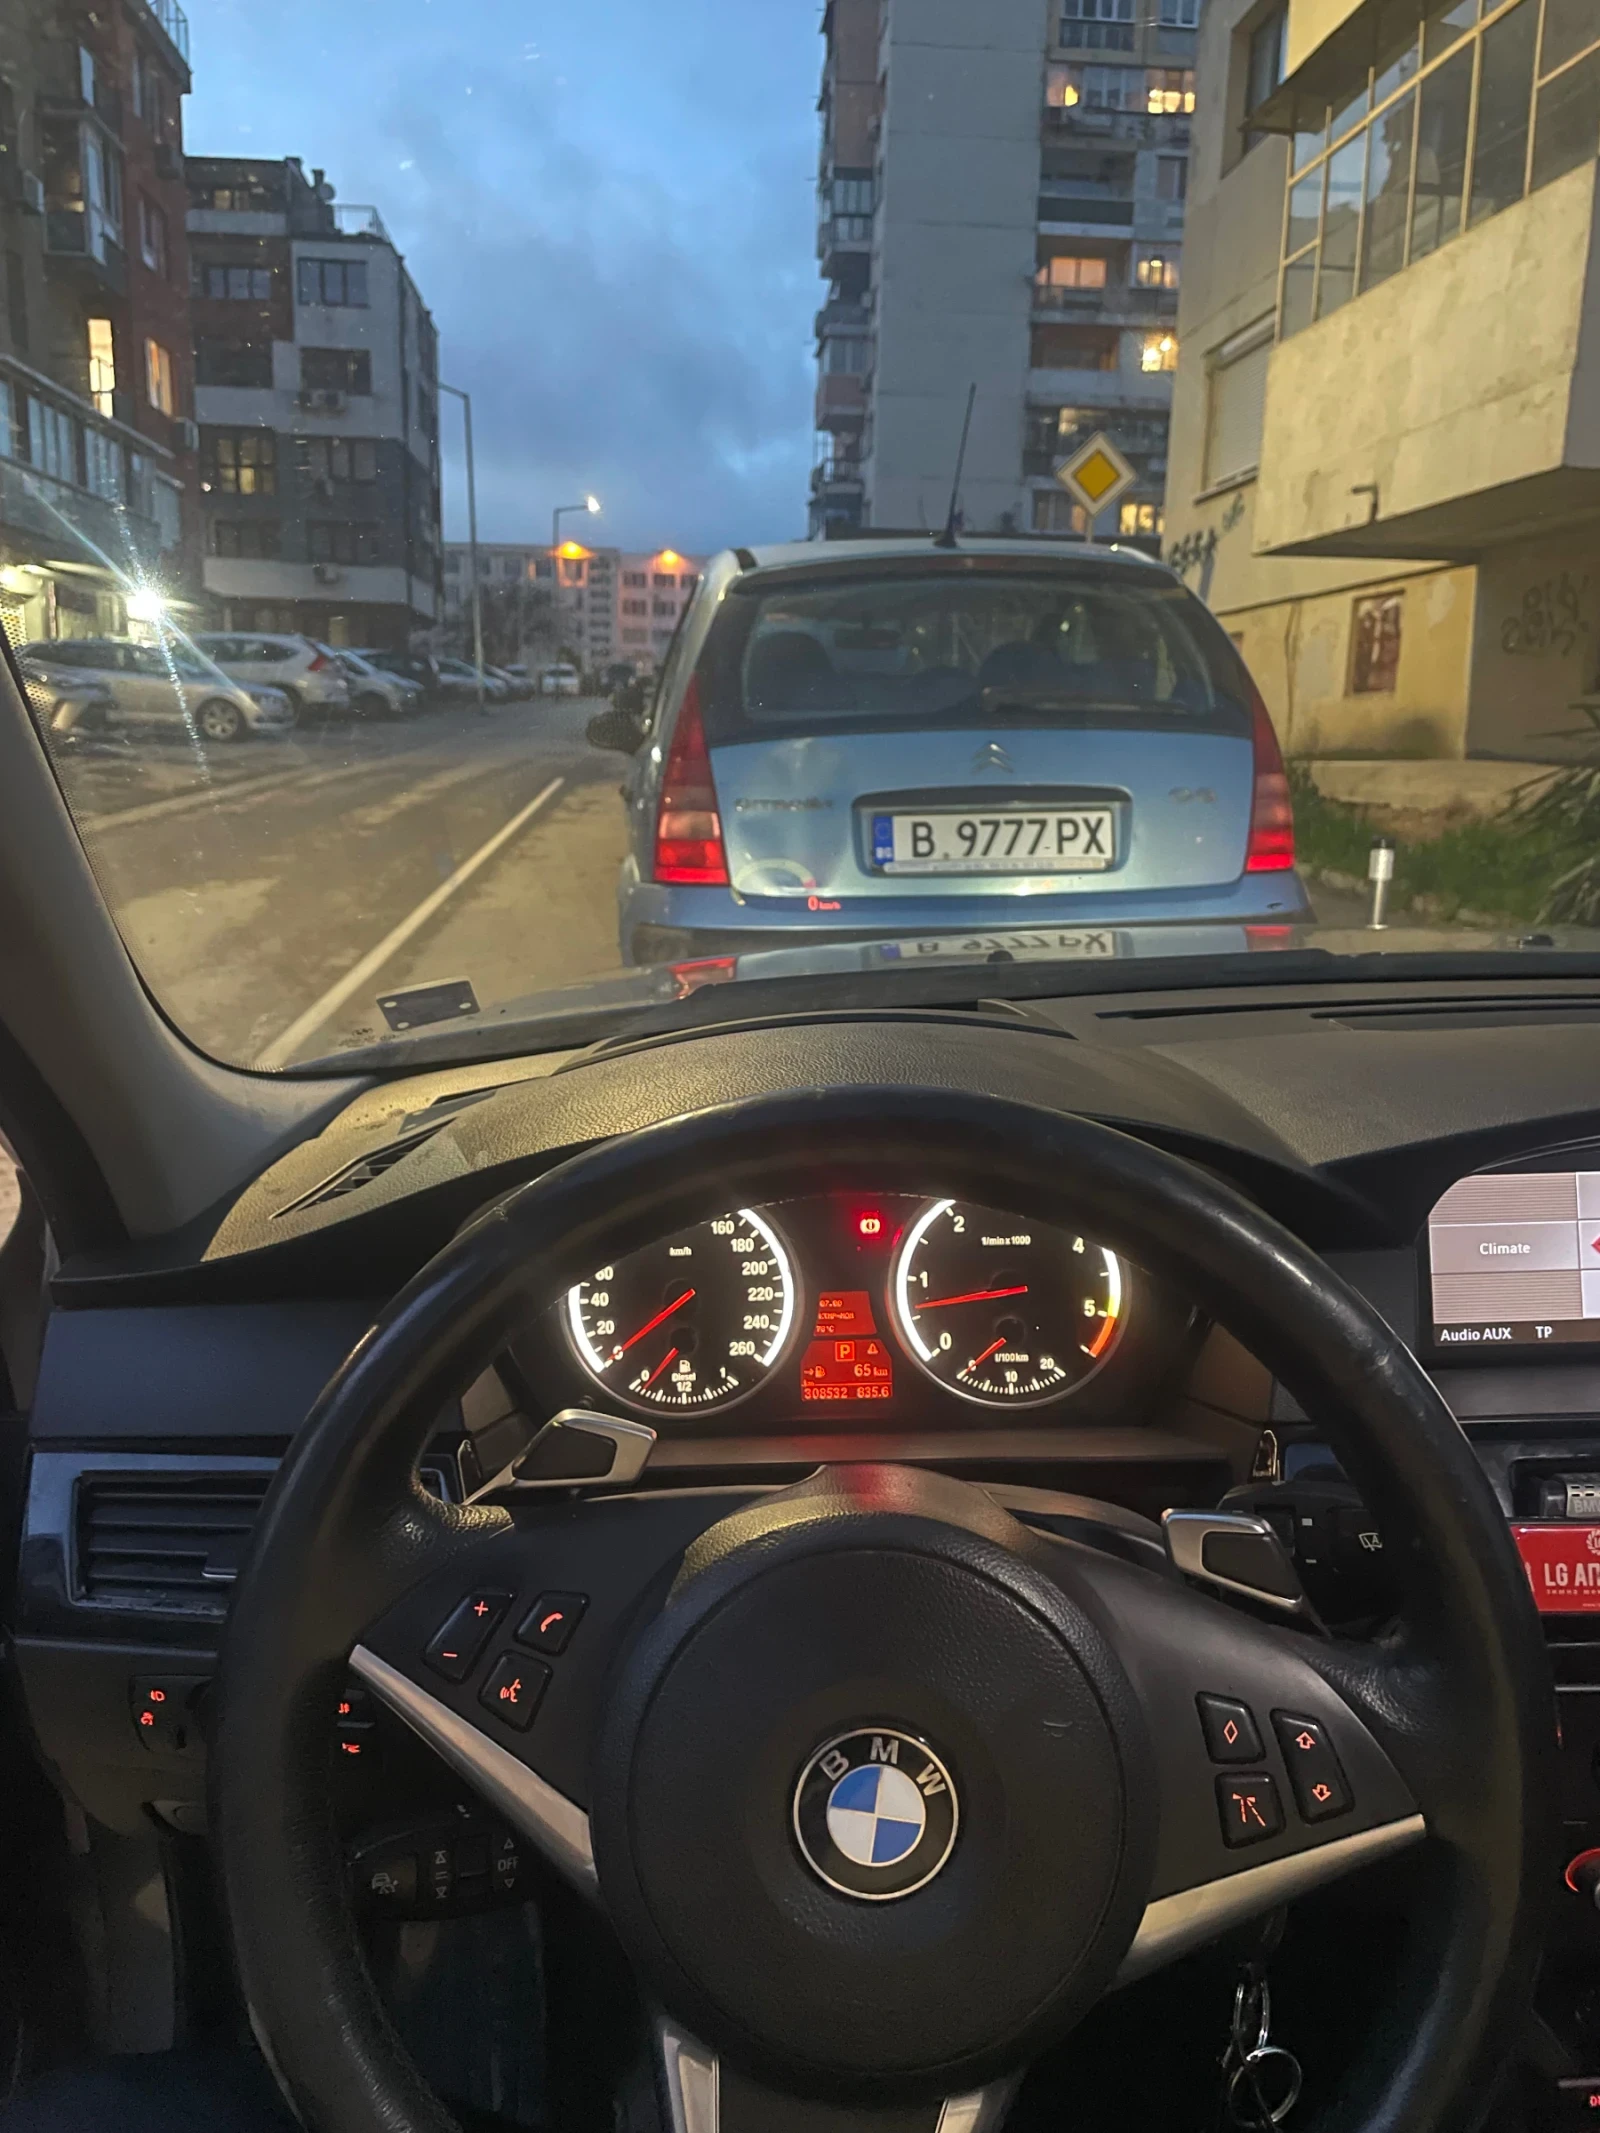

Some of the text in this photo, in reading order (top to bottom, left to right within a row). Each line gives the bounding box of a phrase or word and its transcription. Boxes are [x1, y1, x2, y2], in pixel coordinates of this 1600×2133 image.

[911, 816, 1106, 858] B 9777 PX
[711, 1220, 735, 1235] 160
[953, 1215, 965, 1233] 2
[731, 1238, 754, 1252] 180
[1011, 1235, 1031, 1246] 1000
[1072, 1237, 1085, 1254] 4
[669, 1246, 692, 1257] km/h
[1479, 1243, 1531, 1255] Climate
[595, 1266, 614, 1280] 60
[742, 1261, 768, 1275] 200
[919, 1271, 929, 1288] 1
[591, 1293, 609, 1307] 40
[748, 1287, 774, 1301] 220
[1084, 1299, 1096, 1317] 5
[596, 1320, 615, 1335] 20
[743, 1315, 769, 1330] 240
[1440, 1325, 1553, 1342] Audio AUX TP
[729, 1341, 755, 1356] 260
[940, 1332, 952, 1351] 0
[840, 1344, 851, 1359] P
[854, 1363, 888, 1377] 65 km
[1040, 1357, 1055, 1370] 20
[641, 1370, 650, 1381] 0
[671, 1372, 697, 1382] Diesel
[719, 1366, 726, 1378] 1
[1005, 1371, 1018, 1382] 10
[676, 1381, 692, 1393] 1/2
[804, 1387, 848, 1400] 308532
[1543, 1562, 1568, 1588] LG
[819, 1736, 947, 1797] BMW
[497, 1856, 519, 1872] OFF
